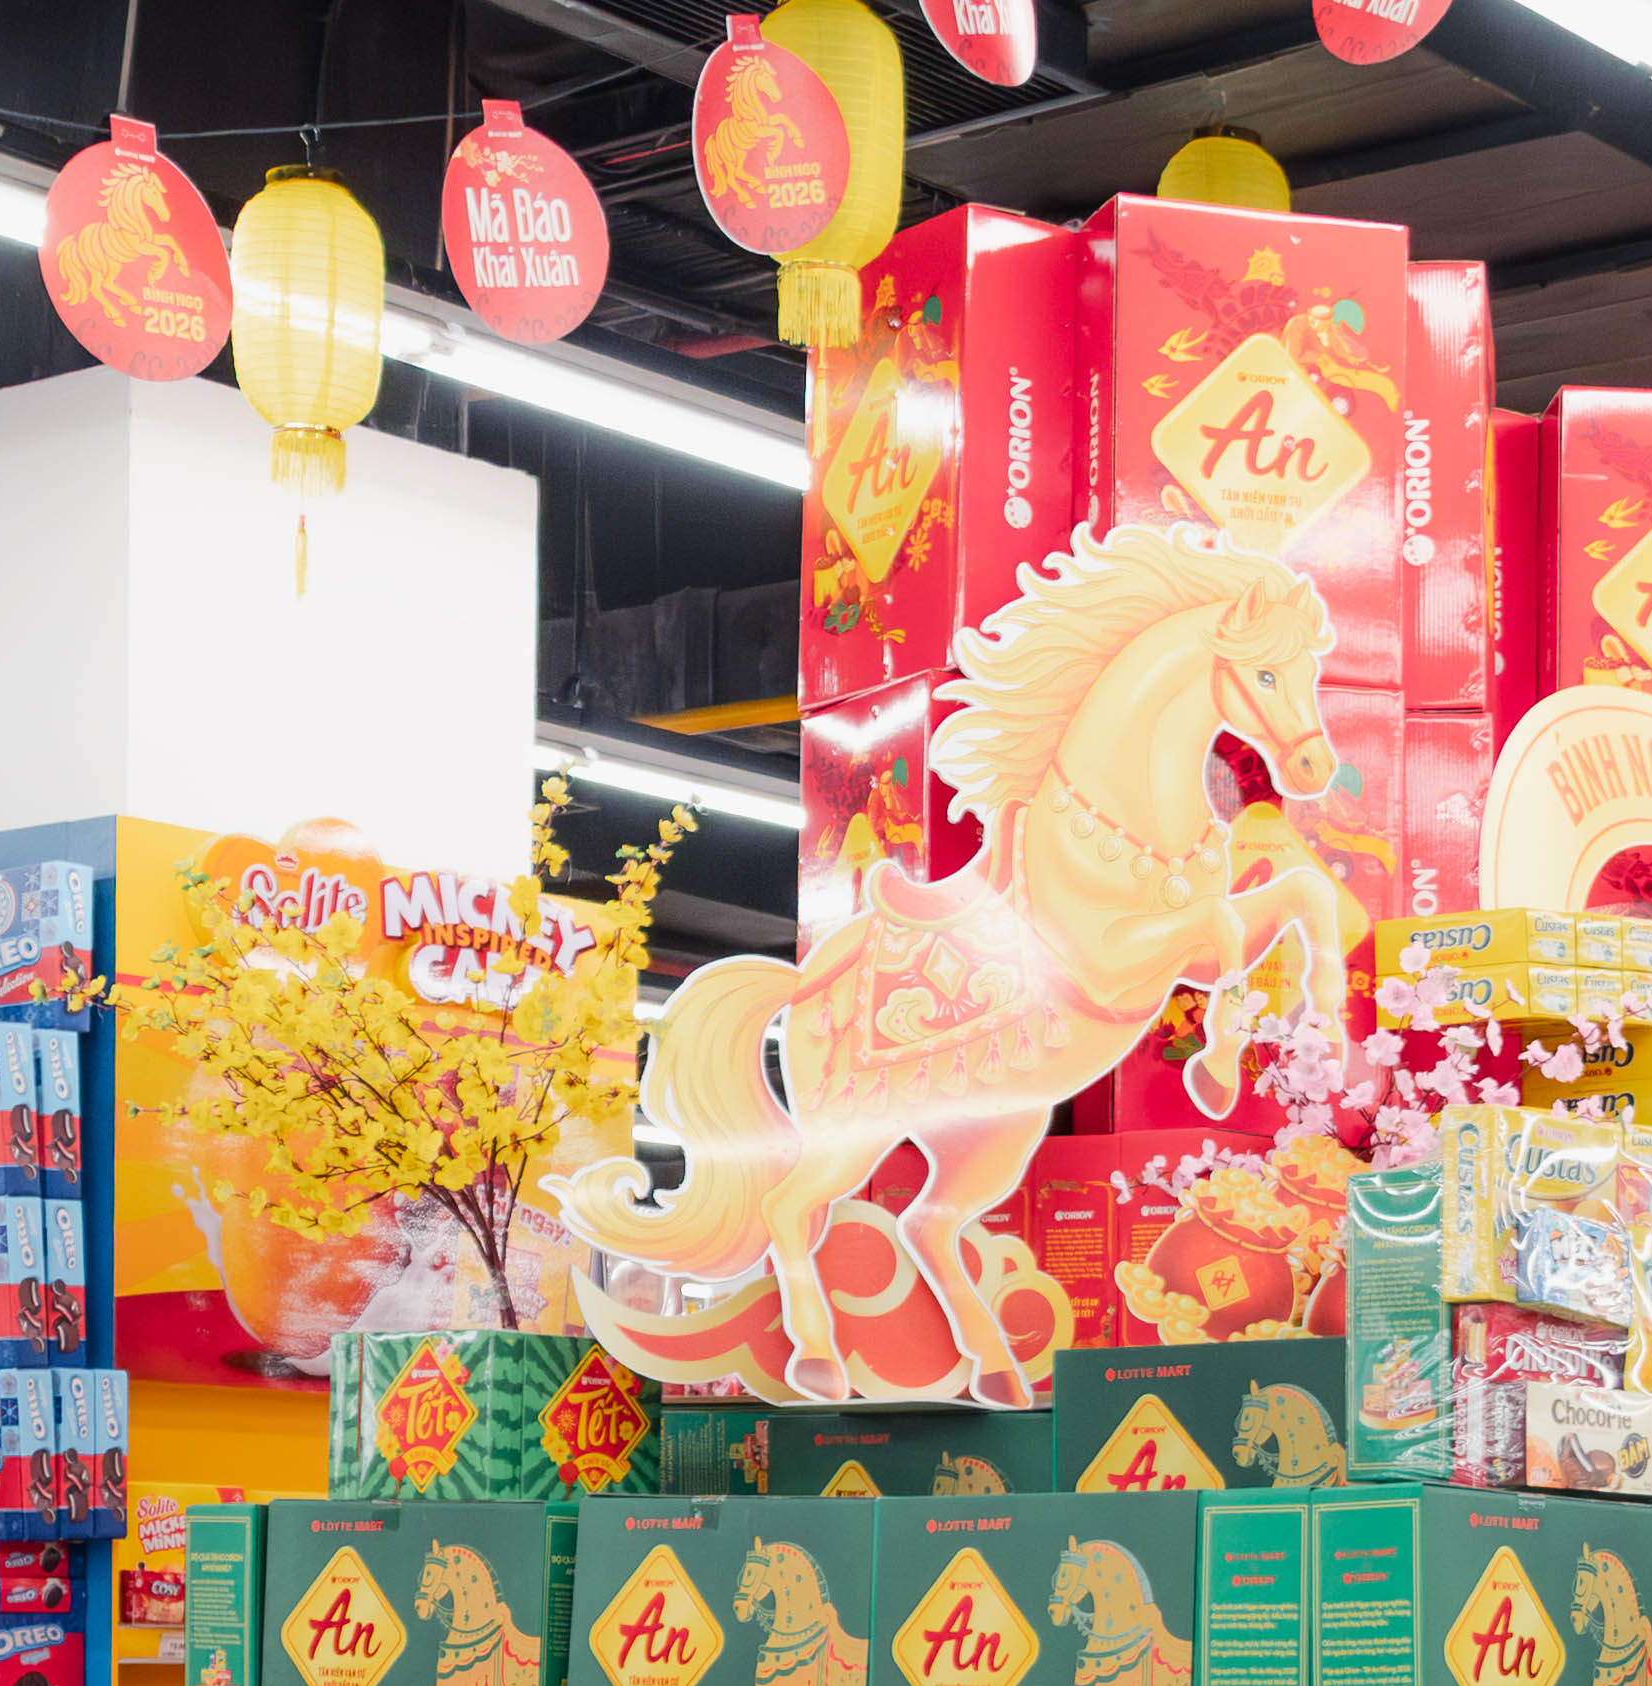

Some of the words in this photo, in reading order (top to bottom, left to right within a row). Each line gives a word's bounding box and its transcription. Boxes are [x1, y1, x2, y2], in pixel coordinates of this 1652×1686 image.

[468, 186, 509, 244] Mã
[516, 189, 573, 244] Đáo
[766, 180, 825, 209] 2026
[474, 244, 517, 289] Khai
[524, 247, 580, 288] Xuân
[145, 306, 206, 342] 2026
[1009, 366, 1036, 493] ORION
[1201, 391, 1328, 488] An
[847, 414, 917, 512] An
[1404, 411, 1433, 540] ORION
[1547, 732, 1627, 828] BÍNH
[1117, 1368, 1154, 1379] LOTTE
[1157, 1366, 1191, 1377] MART
[398, 1379, 451, 1444] Tết
[568, 1387, 626, 1450] Tết
[1552, 1399, 1632, 1429] ChocoPie
[137, 1496, 177, 1519] Solite
[152, 1581, 181, 1596] COSY
[924, 1595, 1008, 1675] An
